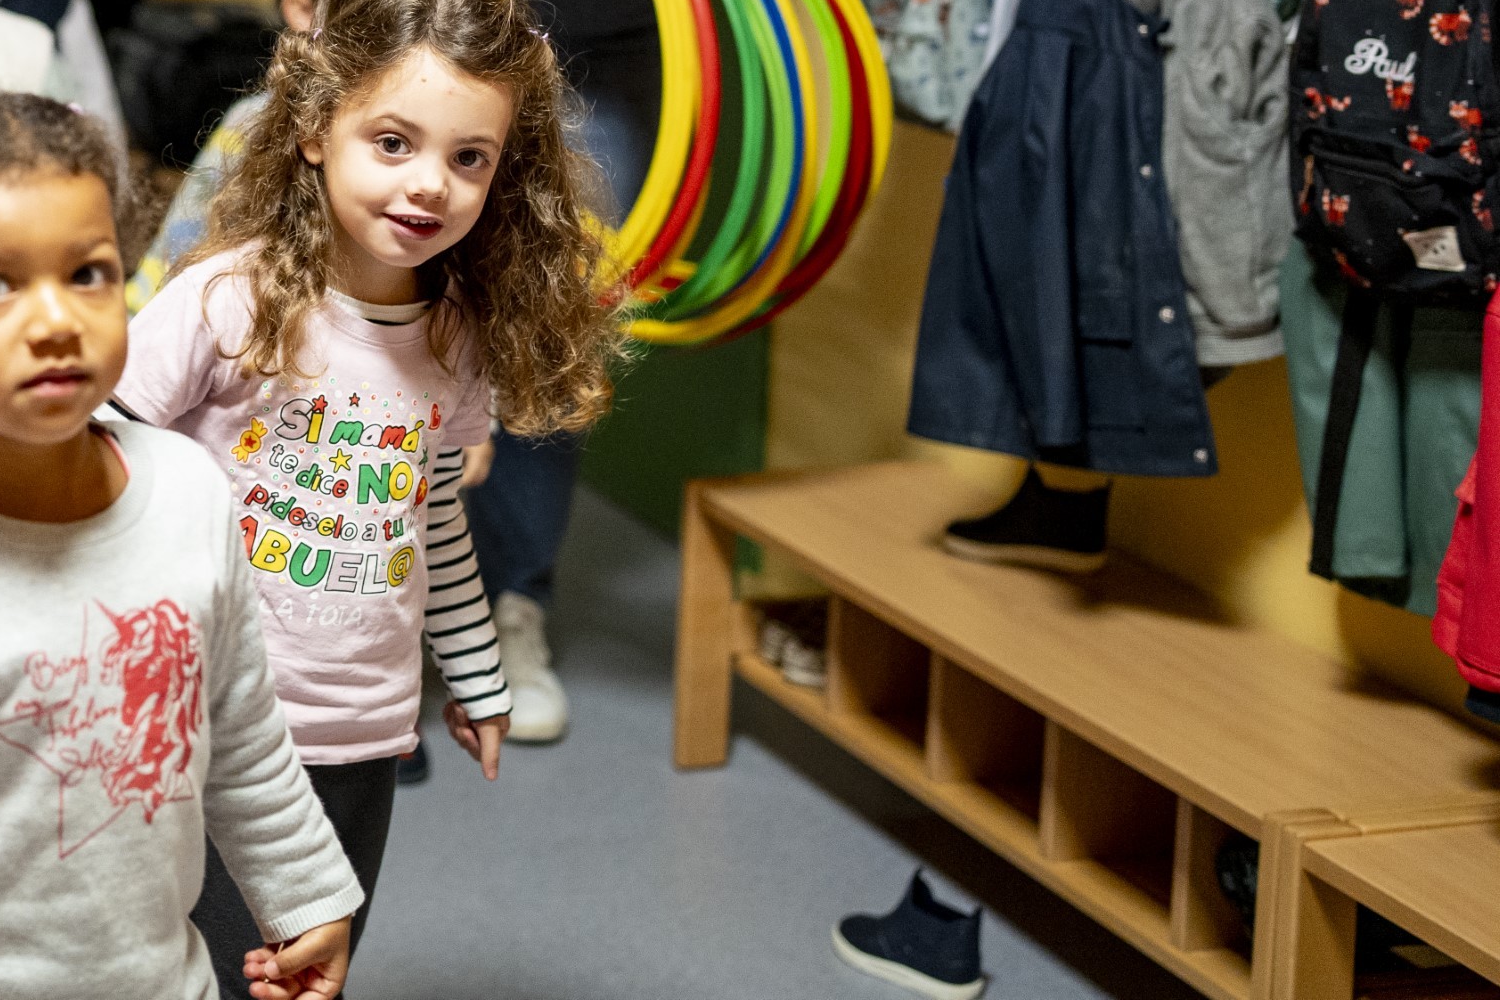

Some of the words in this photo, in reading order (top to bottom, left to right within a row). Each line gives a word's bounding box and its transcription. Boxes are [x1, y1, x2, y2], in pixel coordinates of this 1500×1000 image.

[1344, 37, 1417, 83] Paul
[329, 420, 424, 453] mamá
[269, 444, 298, 473] te
[296, 463, 349, 498] dice
[357, 461, 413, 504] NO
[362, 523, 376, 541] a
[382, 517, 403, 541] tu
